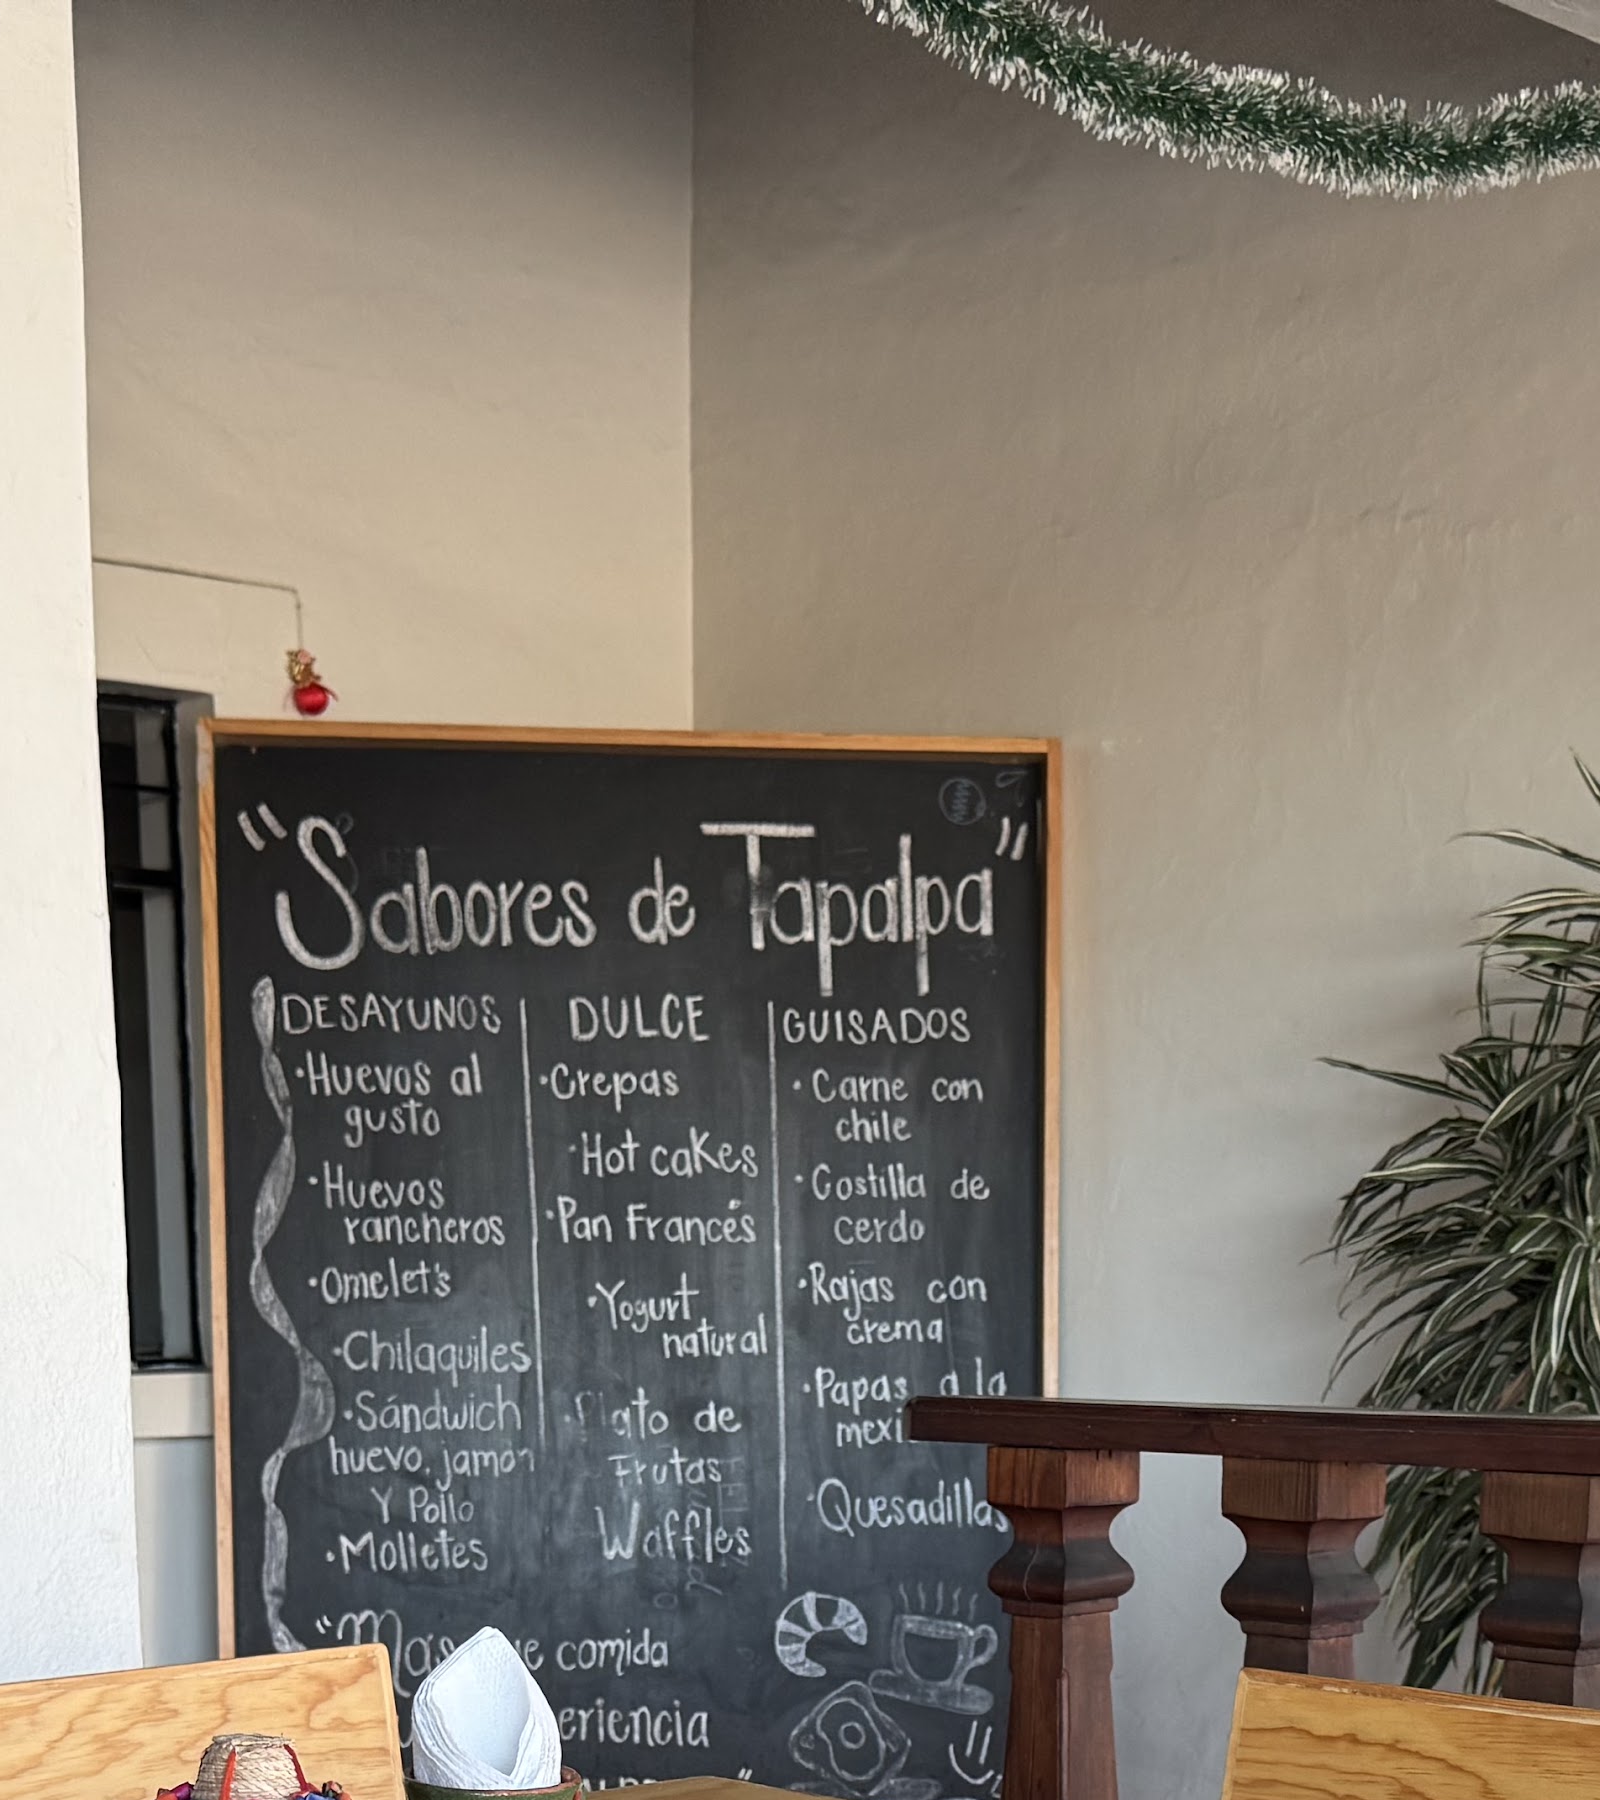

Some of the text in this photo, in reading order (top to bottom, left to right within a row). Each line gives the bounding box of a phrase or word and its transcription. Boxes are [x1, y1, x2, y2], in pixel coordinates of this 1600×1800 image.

[628, 855, 697, 946] de
[280, 992, 502, 1035] DESAYUNOS
[568, 992, 710, 1042] DULCE
[782, 1006, 972, 1045] GUISADOS
[305, 1050, 483, 1097] Huevos al
[551, 1061, 680, 1113] Crepas
[811, 1067, 984, 1104] Carne con
[343, 1097, 441, 1149] gusto
[835, 1106, 912, 1145] chile
[581, 1127, 640, 1179] Hot
[322, 1159, 446, 1210] Huevos
[811, 1161, 991, 1200] Costilla de
[343, 1211, 506, 1246] rancheros
[556, 1194, 758, 1247] Pan Francés
[833, 1208, 926, 1245] cerdo
[320, 1256, 452, 1304] Omelet's
[595, 1271, 700, 1334] Yogurt
[808, 1260, 988, 1322] Rajas con
[662, 1312, 768, 1360] natural
[846, 1317, 944, 1345] crema
[341, 1324, 533, 1388] Chilaquiles
[814, 1356, 1008, 1416] Papas a la
[693, 1399, 743, 1434] de
[836, 1406, 921, 1449] mexi
[607, 1446, 723, 1489] Frutas
[408, 1484, 476, 1525] Pollo
[338, 1528, 489, 1576] Molletes
[593, 1500, 752, 1564] Waffles
[555, 1627, 669, 1676] comida
[558, 1698, 710, 1748] eriencia
